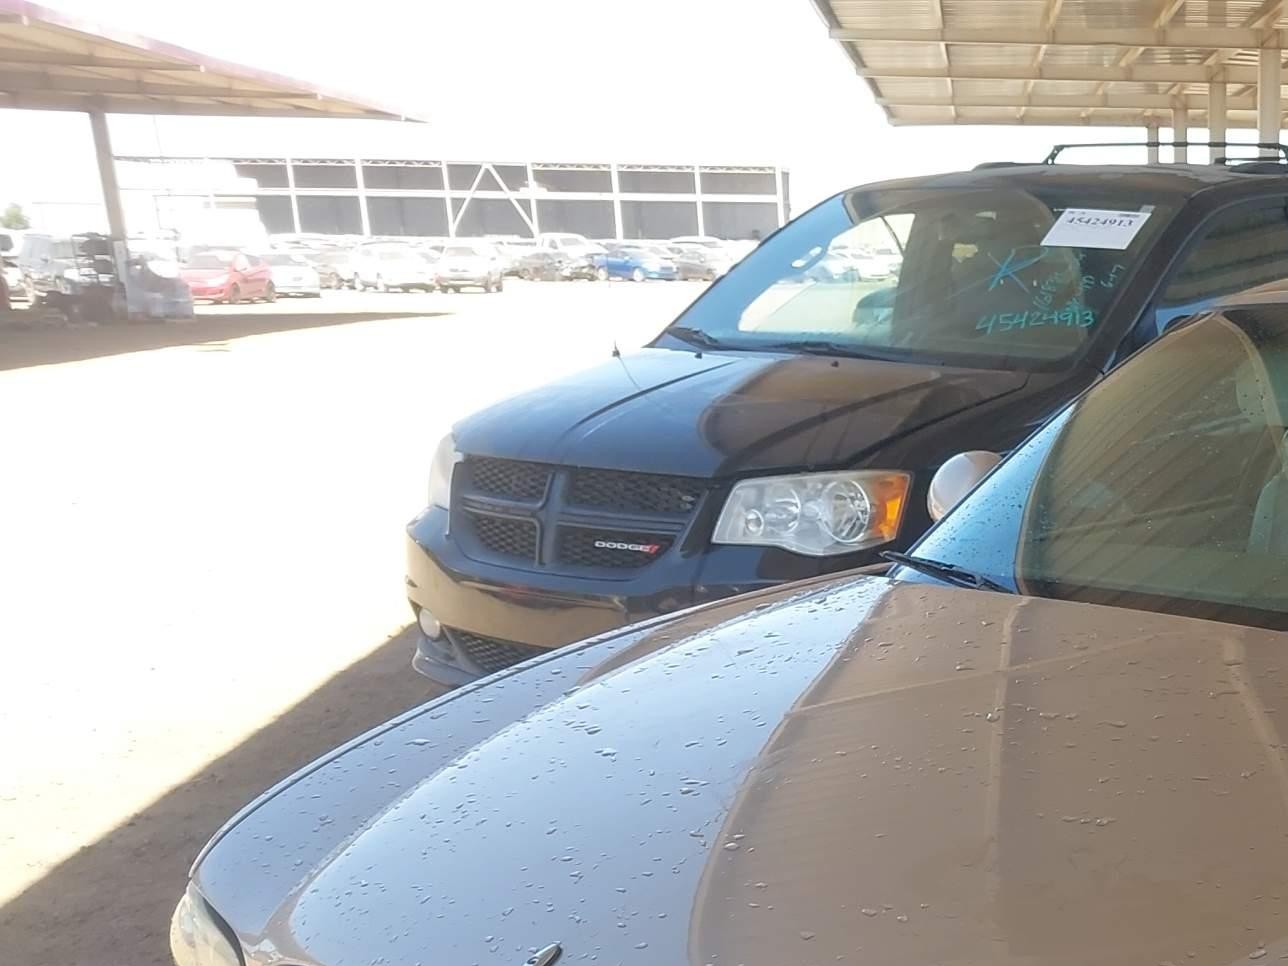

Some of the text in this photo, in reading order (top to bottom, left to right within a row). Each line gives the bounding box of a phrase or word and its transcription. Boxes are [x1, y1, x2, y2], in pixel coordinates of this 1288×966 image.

[1067, 216, 1134, 228] 45424913
[975, 310, 1094, 334] 45424913
[594, 540, 652, 553] DODGE
